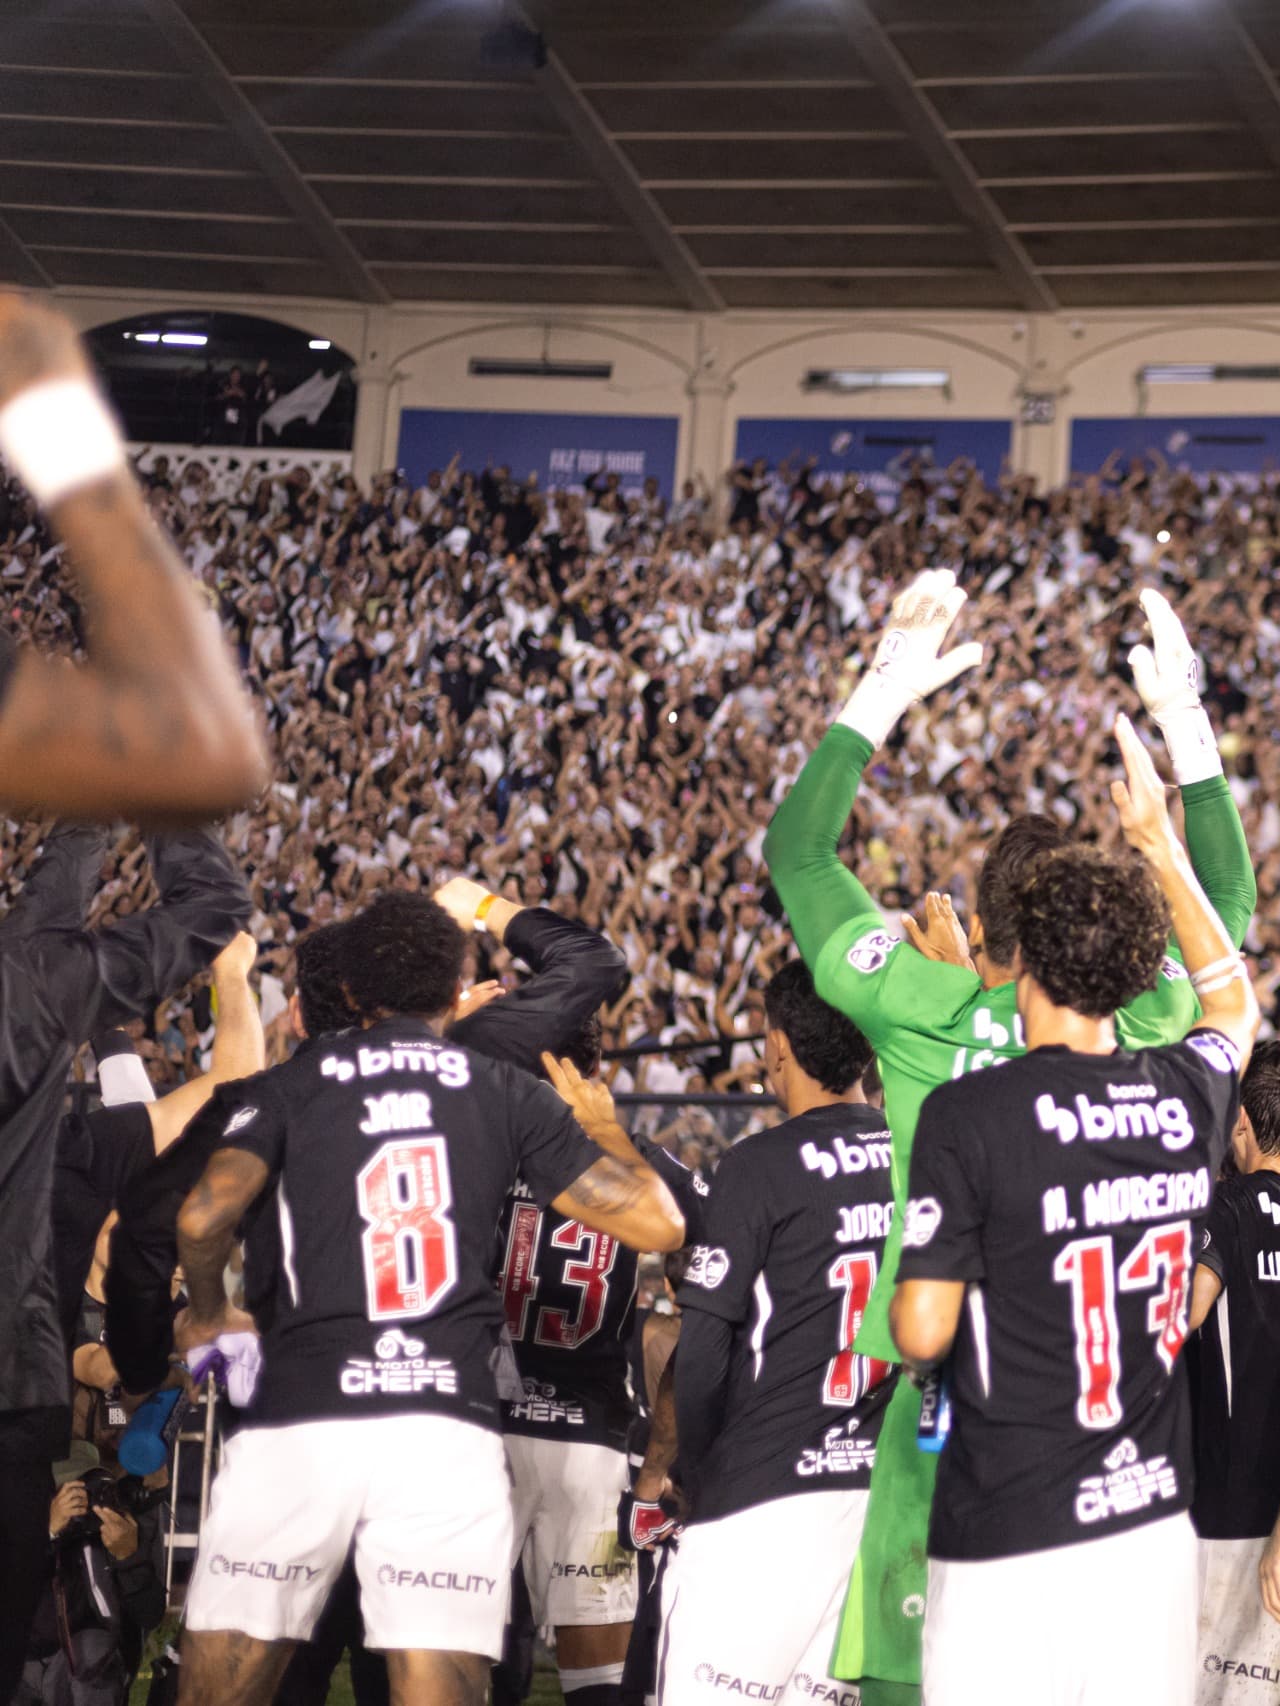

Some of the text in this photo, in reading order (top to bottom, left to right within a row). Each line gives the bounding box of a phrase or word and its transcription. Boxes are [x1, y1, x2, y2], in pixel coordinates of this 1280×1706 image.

[391, 1041, 443, 1050] banco
[357, 1048, 471, 1087] bmg
[1108, 1083, 1158, 1099] banco
[358, 1091, 434, 1135] JAIR
[1076, 1094, 1195, 1150] bmg
[833, 1137, 893, 1173] bm
[1042, 1167, 1210, 1233] N. MOREIRA
[357, 1136, 458, 1322] 8
[823, 1251, 894, 1407] 1
[375, 1361, 424, 1369] MOTO
[340, 1369, 458, 1394] CHEFE
[509, 1402, 584, 1424] HEFE
[825, 1440, 853, 1450] MOTO
[1105, 1463, 1146, 1487] MOTO
[1076, 1467, 1177, 1524] CHEFE
[397, 1570, 496, 1595] FACILITY
[565, 1562, 636, 1578] FACILITY
